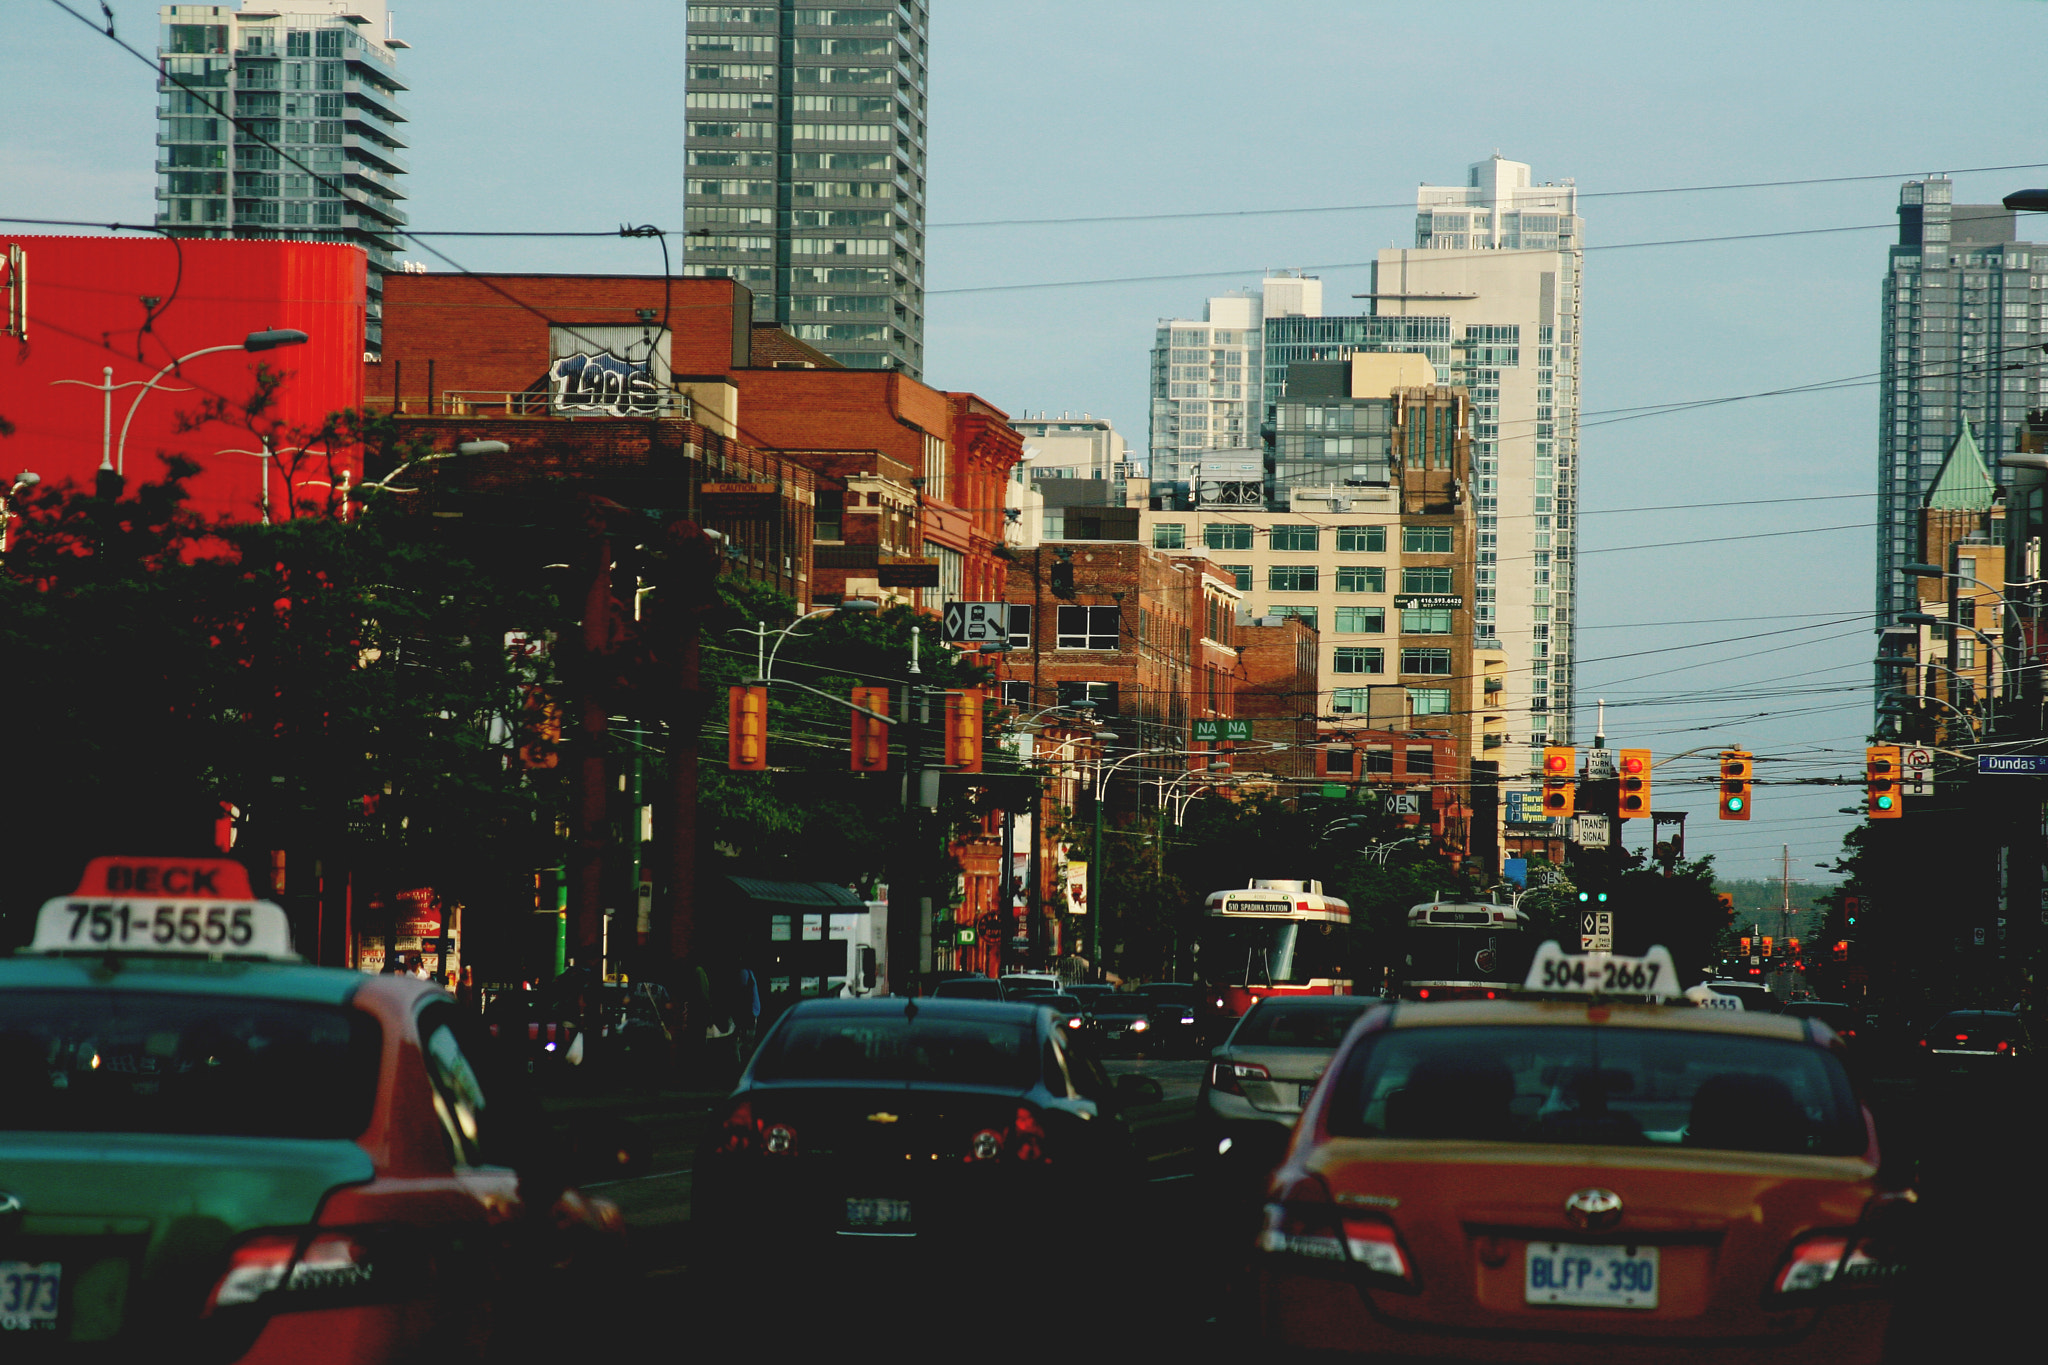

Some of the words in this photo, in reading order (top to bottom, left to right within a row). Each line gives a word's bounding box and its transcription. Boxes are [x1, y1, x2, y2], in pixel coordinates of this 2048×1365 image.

[1198, 722, 1217, 734] NA
[1228, 721, 1247, 733] NA
[1989, 756, 2036, 770] Dundas
[1580, 819, 1607, 829] TRANSIT
[1582, 831, 1606, 842] SIGNAL
[107, 865, 220, 894] BECK
[1228, 903, 1239, 911] 510
[1240, 903, 1265, 912] SPADINA
[1265, 904, 1288, 912] STATION
[66, 903, 252, 945] 751-5555
[960, 930, 974, 942] TD
[1542, 959, 1660, 989] 504-2667
[1701, 998, 1736, 1010] 5555
[1532, 1257, 1591, 1289] BLFP
[1609, 1261, 1654, 1292] 390
[5, 1273, 58, 1312] 373
